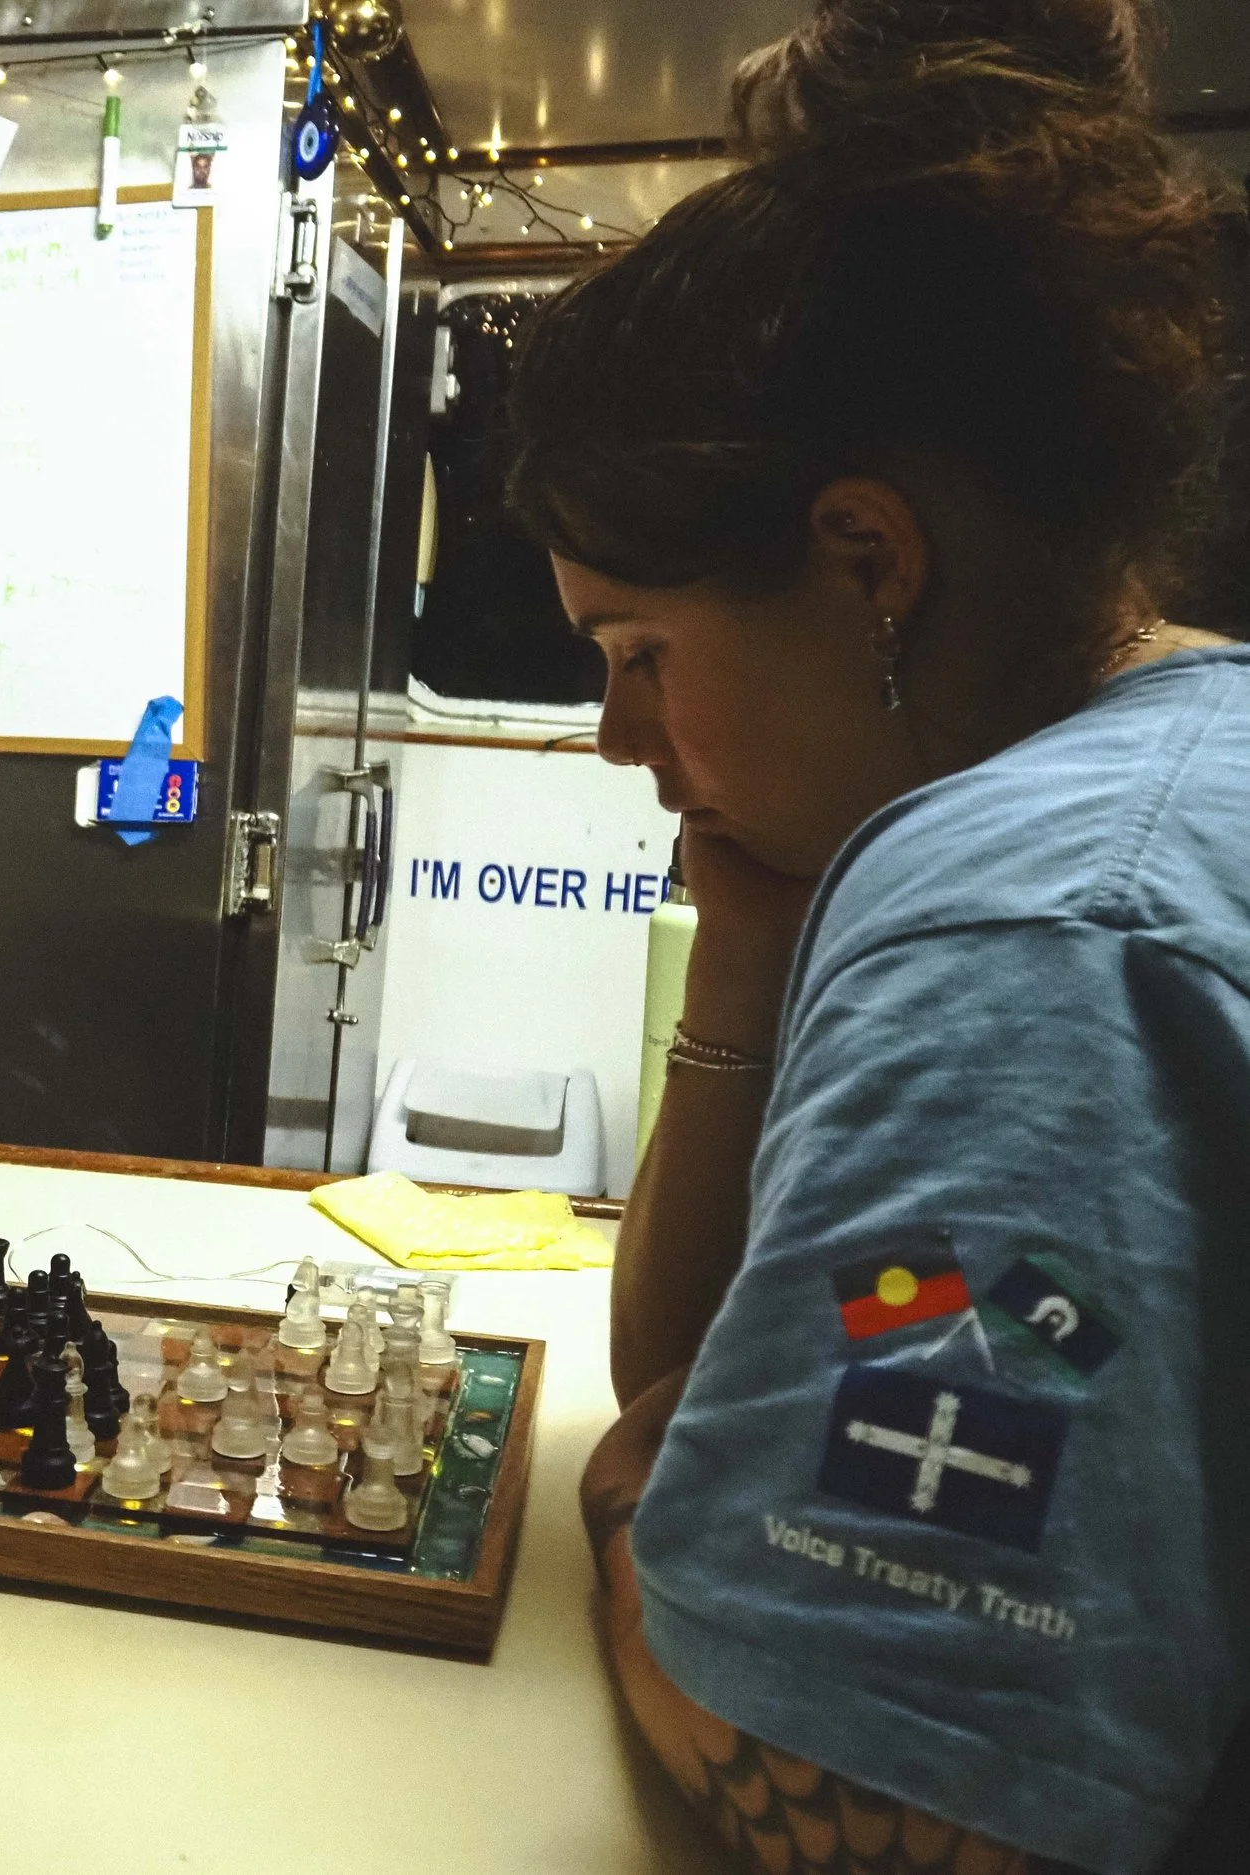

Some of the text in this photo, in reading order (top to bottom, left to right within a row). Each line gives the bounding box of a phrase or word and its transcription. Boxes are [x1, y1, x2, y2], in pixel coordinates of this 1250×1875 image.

[409, 859, 461, 900] I'M
[478, 864, 588, 910] OVER
[764, 1515, 1076, 1640] Voice Treaty Truth
